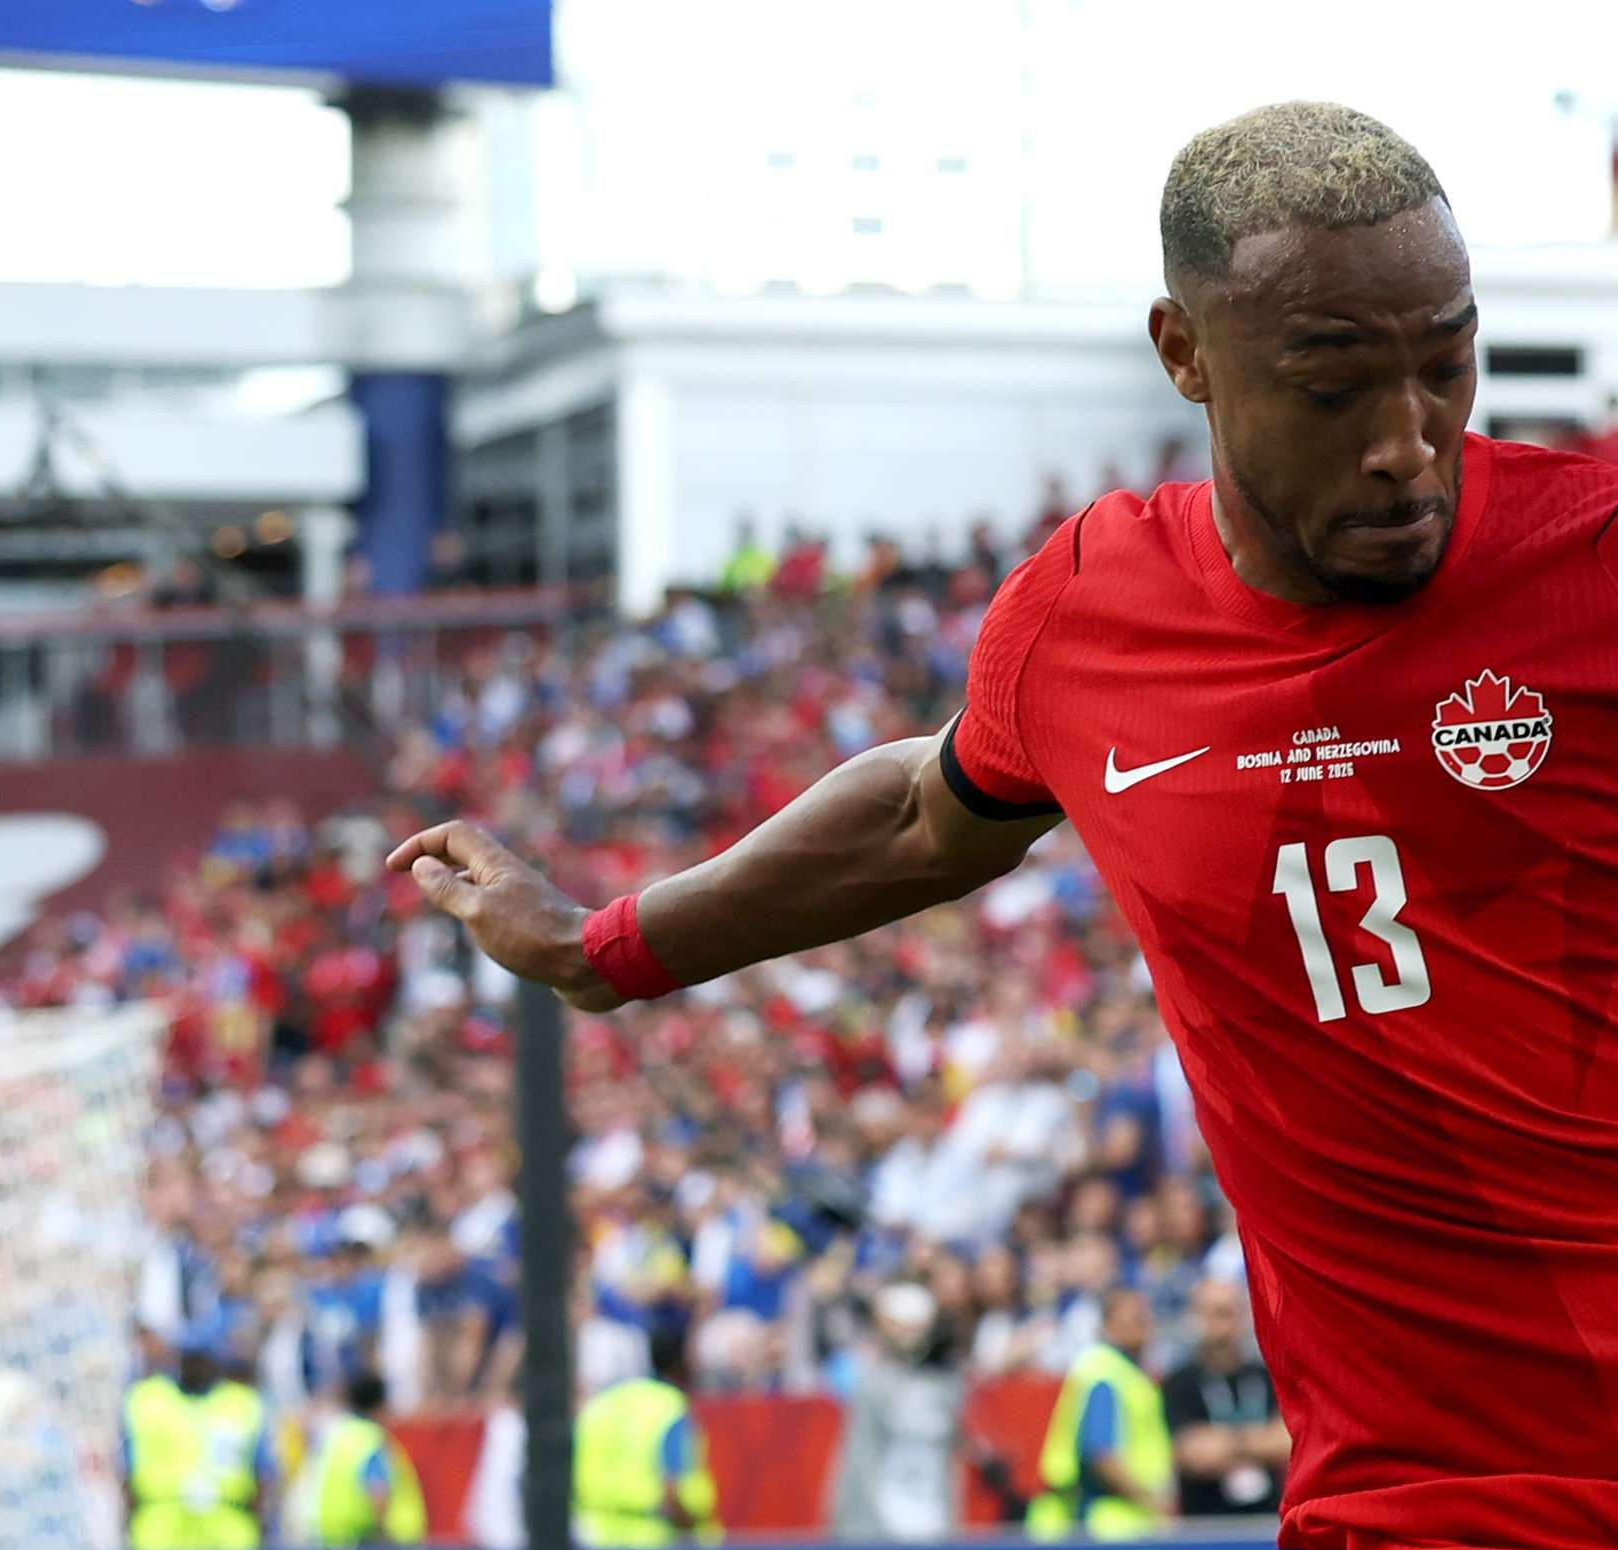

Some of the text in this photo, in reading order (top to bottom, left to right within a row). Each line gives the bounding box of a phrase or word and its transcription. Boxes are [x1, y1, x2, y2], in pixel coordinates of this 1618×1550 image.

[1292, 726, 1341, 745] CANADA
[1435, 721, 1548, 746] CANADA
[1237, 738, 1400, 770] BOSNIA AND HERZEGOVINA
[1280, 762, 1354, 784] 12 JUNE 2026
[1272, 834, 1431, 1023] 13
